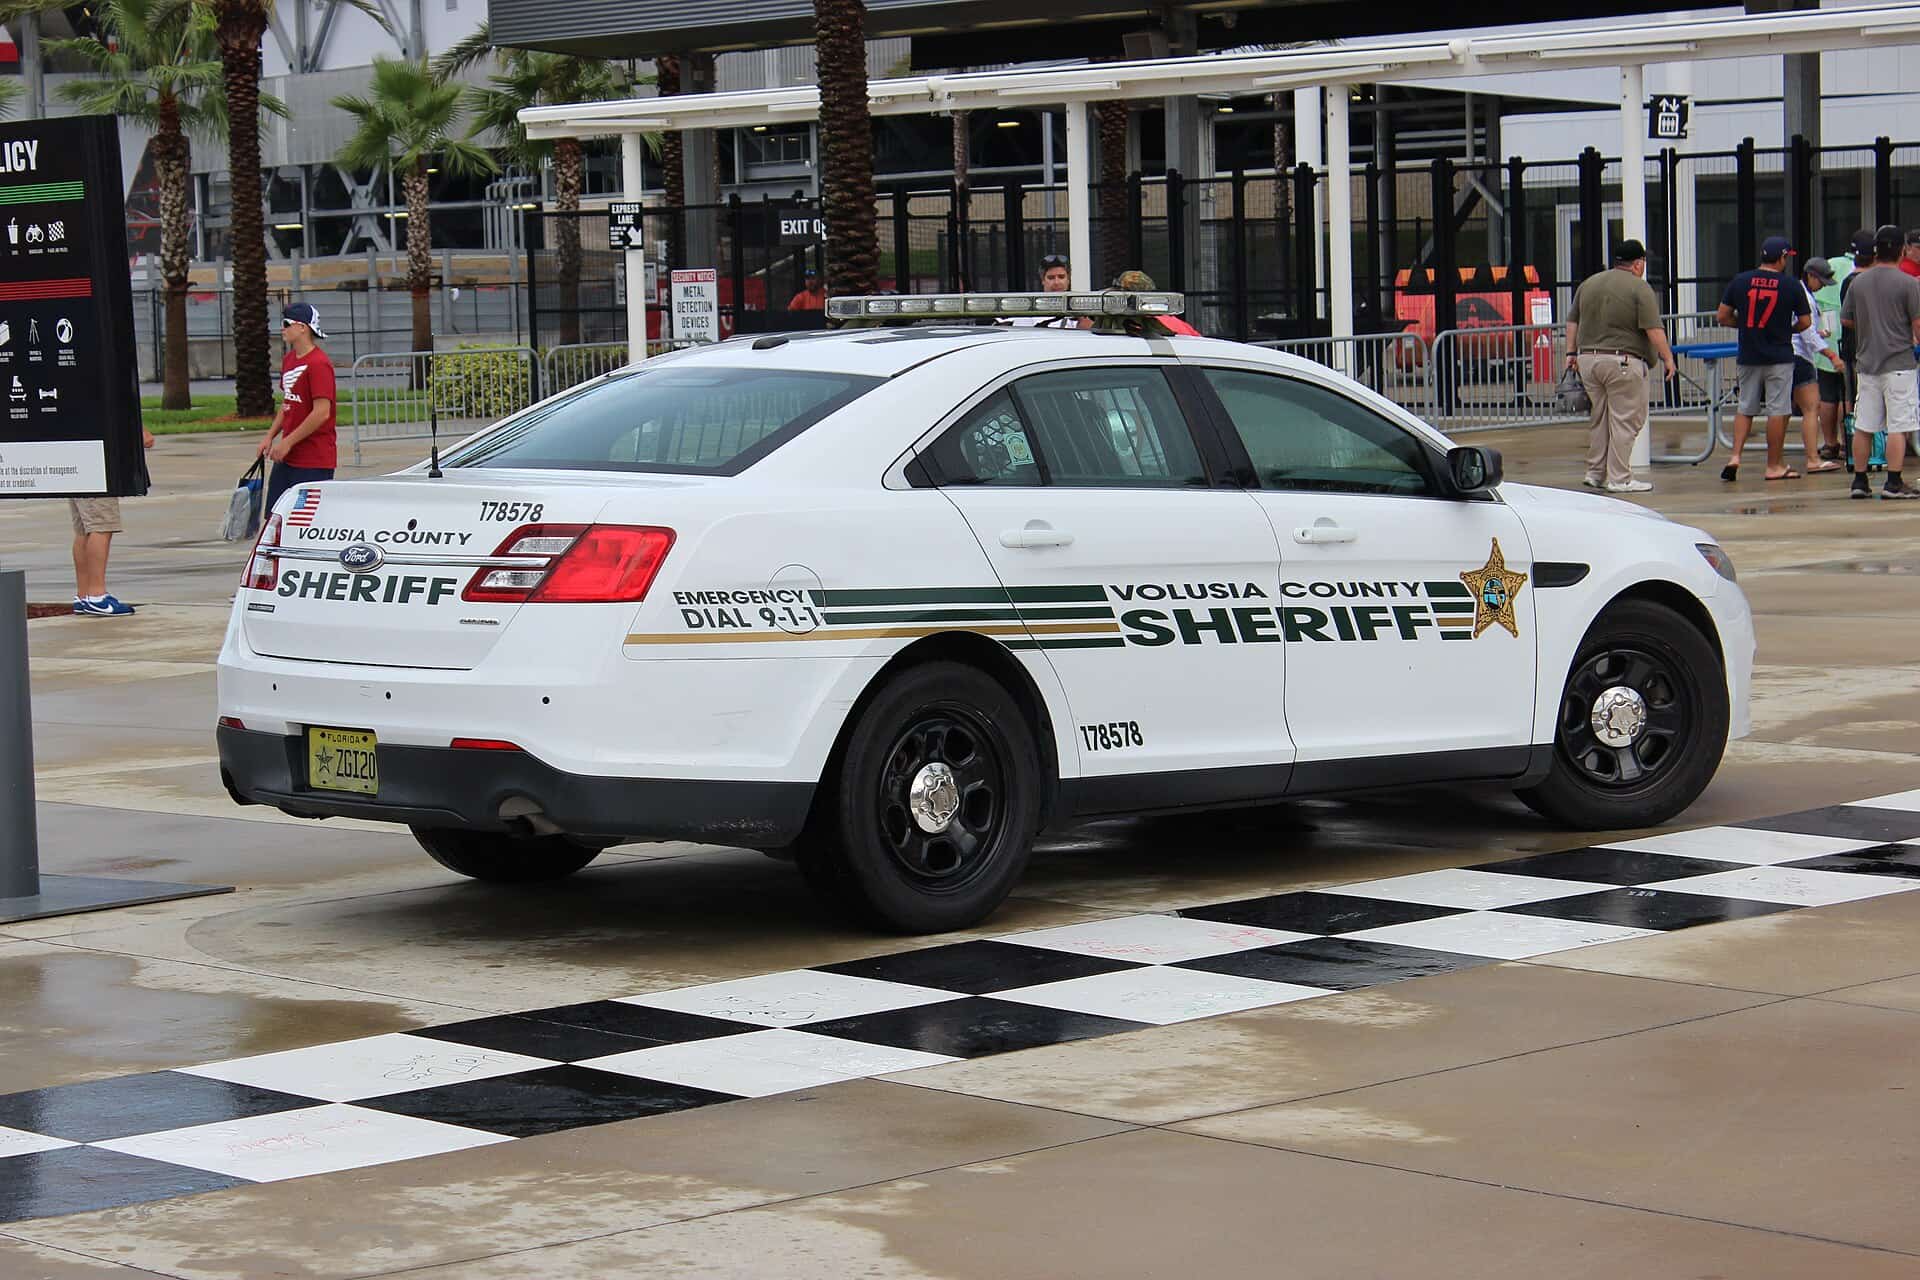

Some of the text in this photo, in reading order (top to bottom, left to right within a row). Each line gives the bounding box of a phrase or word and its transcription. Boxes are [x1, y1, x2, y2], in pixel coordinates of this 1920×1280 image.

[611, 204, 640, 214] EXPRESS
[617, 214, 634, 224] LANE
[781, 219, 809, 234] EXIT
[672, 271, 715, 283] SECURITY NOTICE
[683, 285, 704, 297] METAL
[677, 301, 712, 313] DETECTION
[1747, 288, 1778, 328] 17
[681, 316, 709, 328] DEVICES
[479, 501, 544, 522] 178578
[298, 527, 473, 546] VOLUSIA COUNTY
[344, 547, 370, 562] Ford
[278, 570, 458, 605] SHERIFF
[1109, 581, 1420, 600] VOLUSIA COUNTY
[673, 589, 805, 605] EMERGENCY
[681, 606, 820, 628] DIAL 9-1-1
[1121, 606, 1432, 647] SHERIFF
[327, 733, 360, 744] FLORIDA
[1080, 720, 1143, 751] 178578
